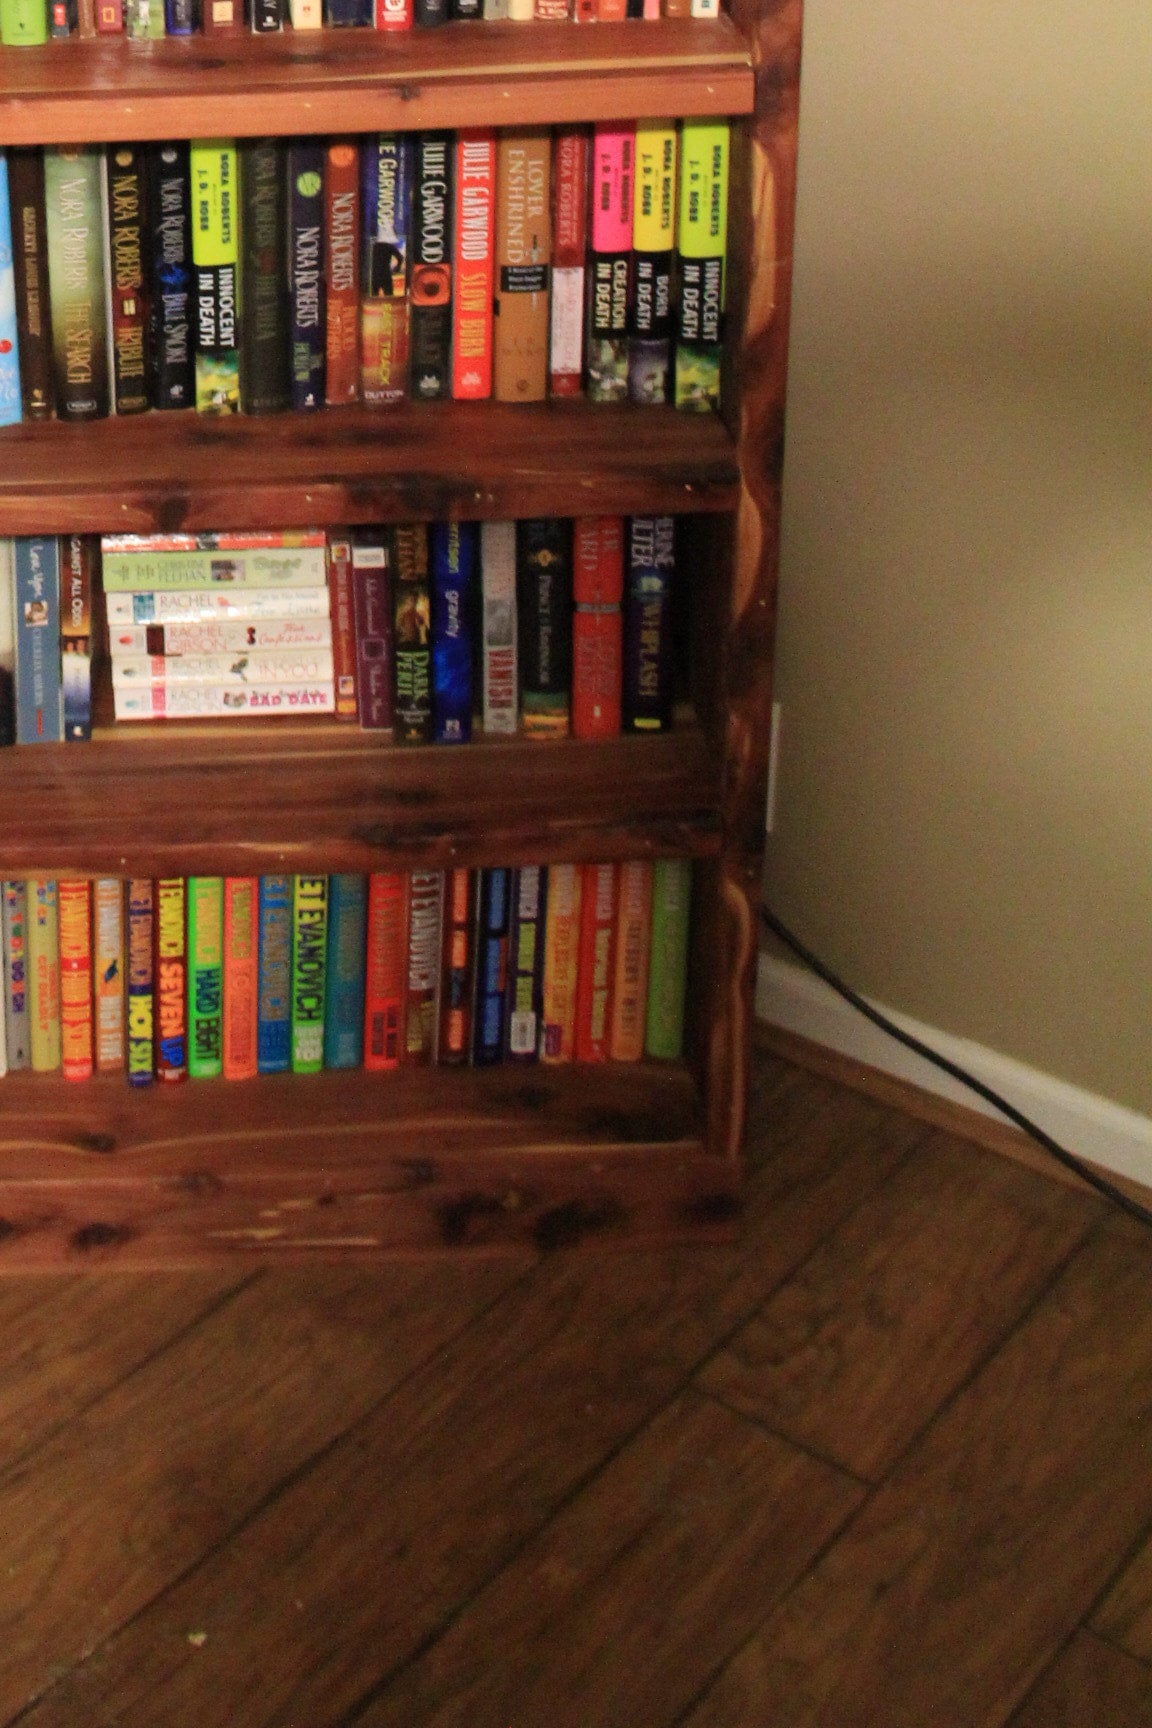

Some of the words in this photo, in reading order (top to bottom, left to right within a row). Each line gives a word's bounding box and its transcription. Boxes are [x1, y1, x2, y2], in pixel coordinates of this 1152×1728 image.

[219, 154, 230, 187] NORA
[422, 142, 446, 180] JULIE
[462, 142, 491, 180] JULIE
[711, 145, 722, 178] NORA
[61, 177, 86, 222] NORA
[112, 174, 138, 221] NORA
[160, 177, 184, 212] NORA
[332, 192, 356, 232] NORA
[507, 149, 525, 264] ENSHRINED
[527, 160, 544, 218] LOVER
[710, 182, 720, 237] ROBERTS
[220, 191, 231, 245] ROBERTS
[421, 181, 448, 263] GARWOOD
[461, 186, 489, 261] GARWOOD
[559, 182, 572, 246] ROBERTS
[114, 226, 141, 291] ROBERTS
[295, 227, 321, 268] NORA
[330, 235, 355, 291] ROBERTS
[597, 262, 611, 279] IN
[637, 262, 651, 279] IN
[199, 273, 214, 291] IN
[460, 273, 487, 312] SLOW
[655, 275, 669, 317] BORN
[683, 264, 699, 283] IN
[199, 295, 215, 346] DEATH
[218, 268, 234, 348] INNOCENT
[294, 271, 320, 328] ROBERTS
[597, 282, 611, 329] DEATH
[637, 282, 651, 330] DEATH
[682, 287, 698, 339] DEATH
[702, 260, 721, 341] INNOCENT
[459, 319, 486, 358] BURN
[71, 578, 82, 597] ALL
[249, 692, 281, 707] BAD
[287, 690, 327, 706] DATE
[414, 650, 430, 701] DARK
[297, 909, 323, 1020] EVANOVICH
[129, 995, 152, 1039] HOT
[159, 962, 185, 1037] SEVEN
[159, 1037, 184, 1068] UP
